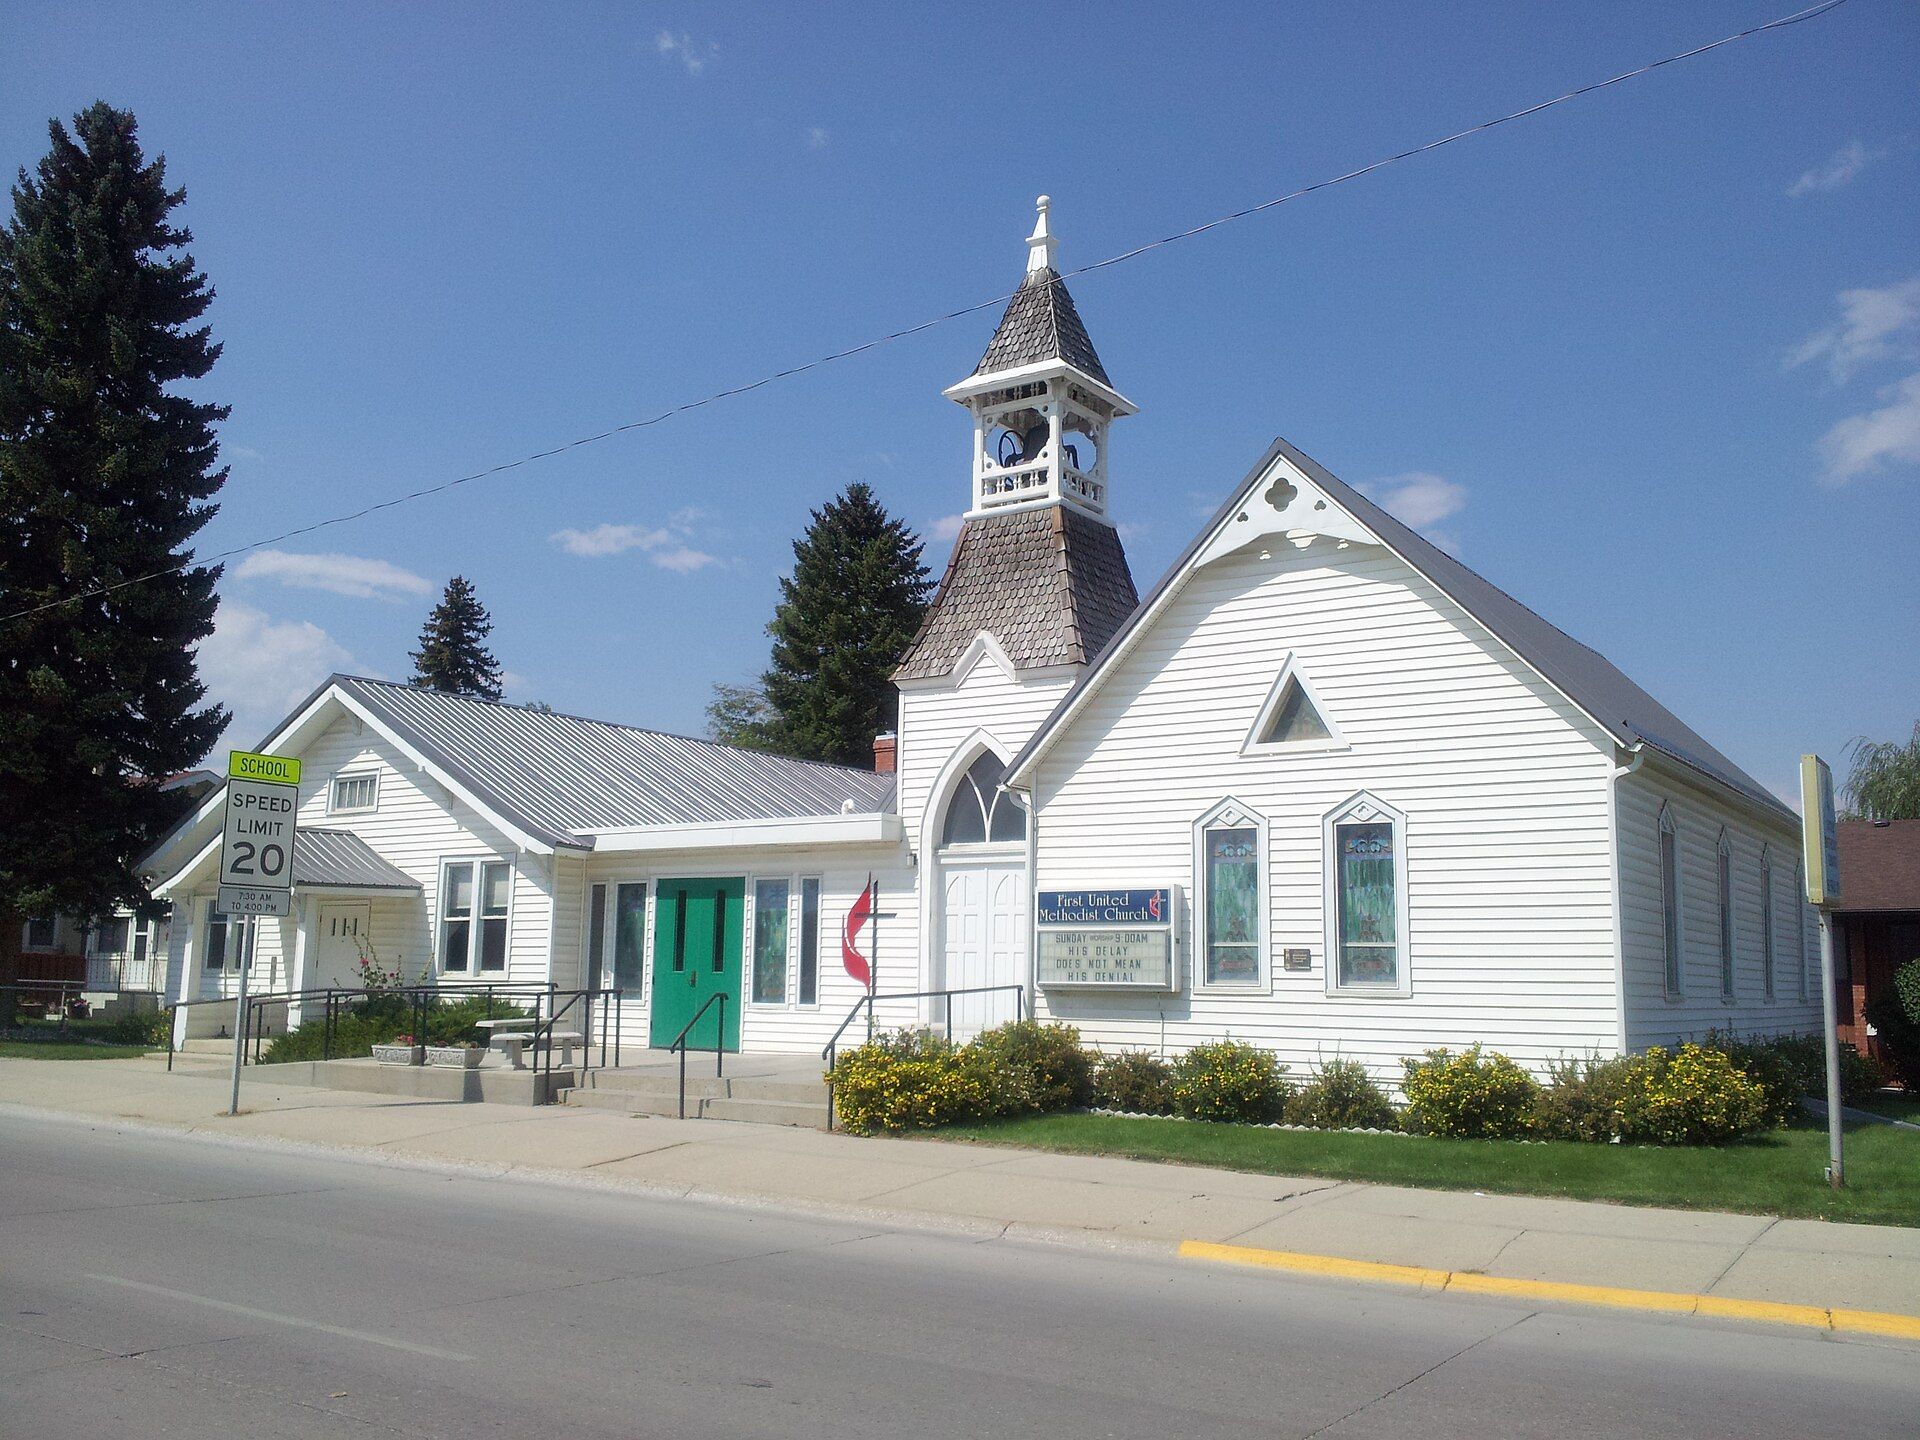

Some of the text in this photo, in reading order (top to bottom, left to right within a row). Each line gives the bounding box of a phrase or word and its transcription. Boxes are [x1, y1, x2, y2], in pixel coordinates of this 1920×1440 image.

[240, 757, 290, 778] SCHOOL
[233, 793, 292, 813] SPEED
[237, 818, 283, 836] LIMIT
[229, 841, 285, 876] 20
[260, 893, 272, 901] AM
[1057, 892, 1129, 907] First United
[232, 901, 241, 910] TO
[265, 904, 277, 912] PM
[1039, 906, 1148, 922] Methodist Church
[1056, 933, 1087, 943] SUNDAY
[1068, 946, 1128, 956] HIS DELAY
[1056, 959, 1141, 969] DOES NOT MEAN
[1068, 971, 1135, 982] HIS DENIAL
